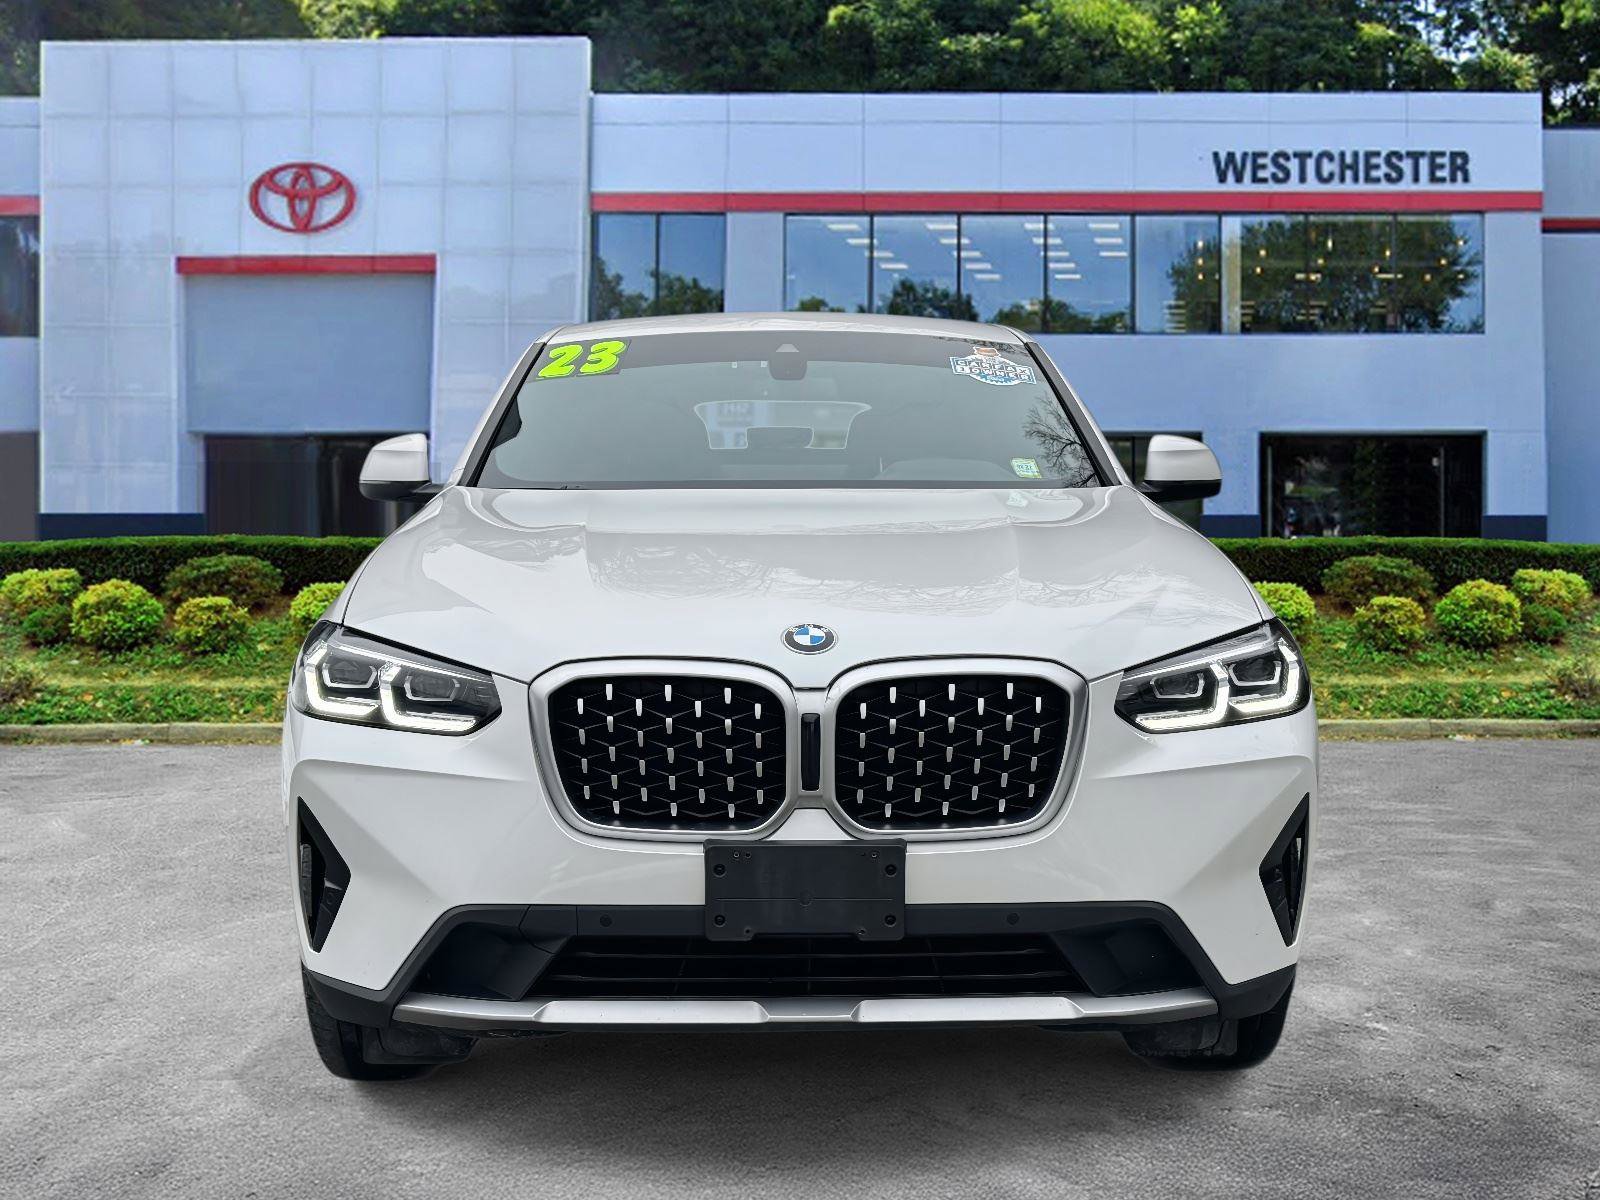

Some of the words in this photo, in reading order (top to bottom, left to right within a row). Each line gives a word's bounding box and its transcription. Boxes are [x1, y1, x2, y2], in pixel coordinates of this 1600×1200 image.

[1212, 150, 1471, 184] WESTCHESTER
[537, 340, 627, 378] 23
[956, 360, 1028, 374] CARFAX
